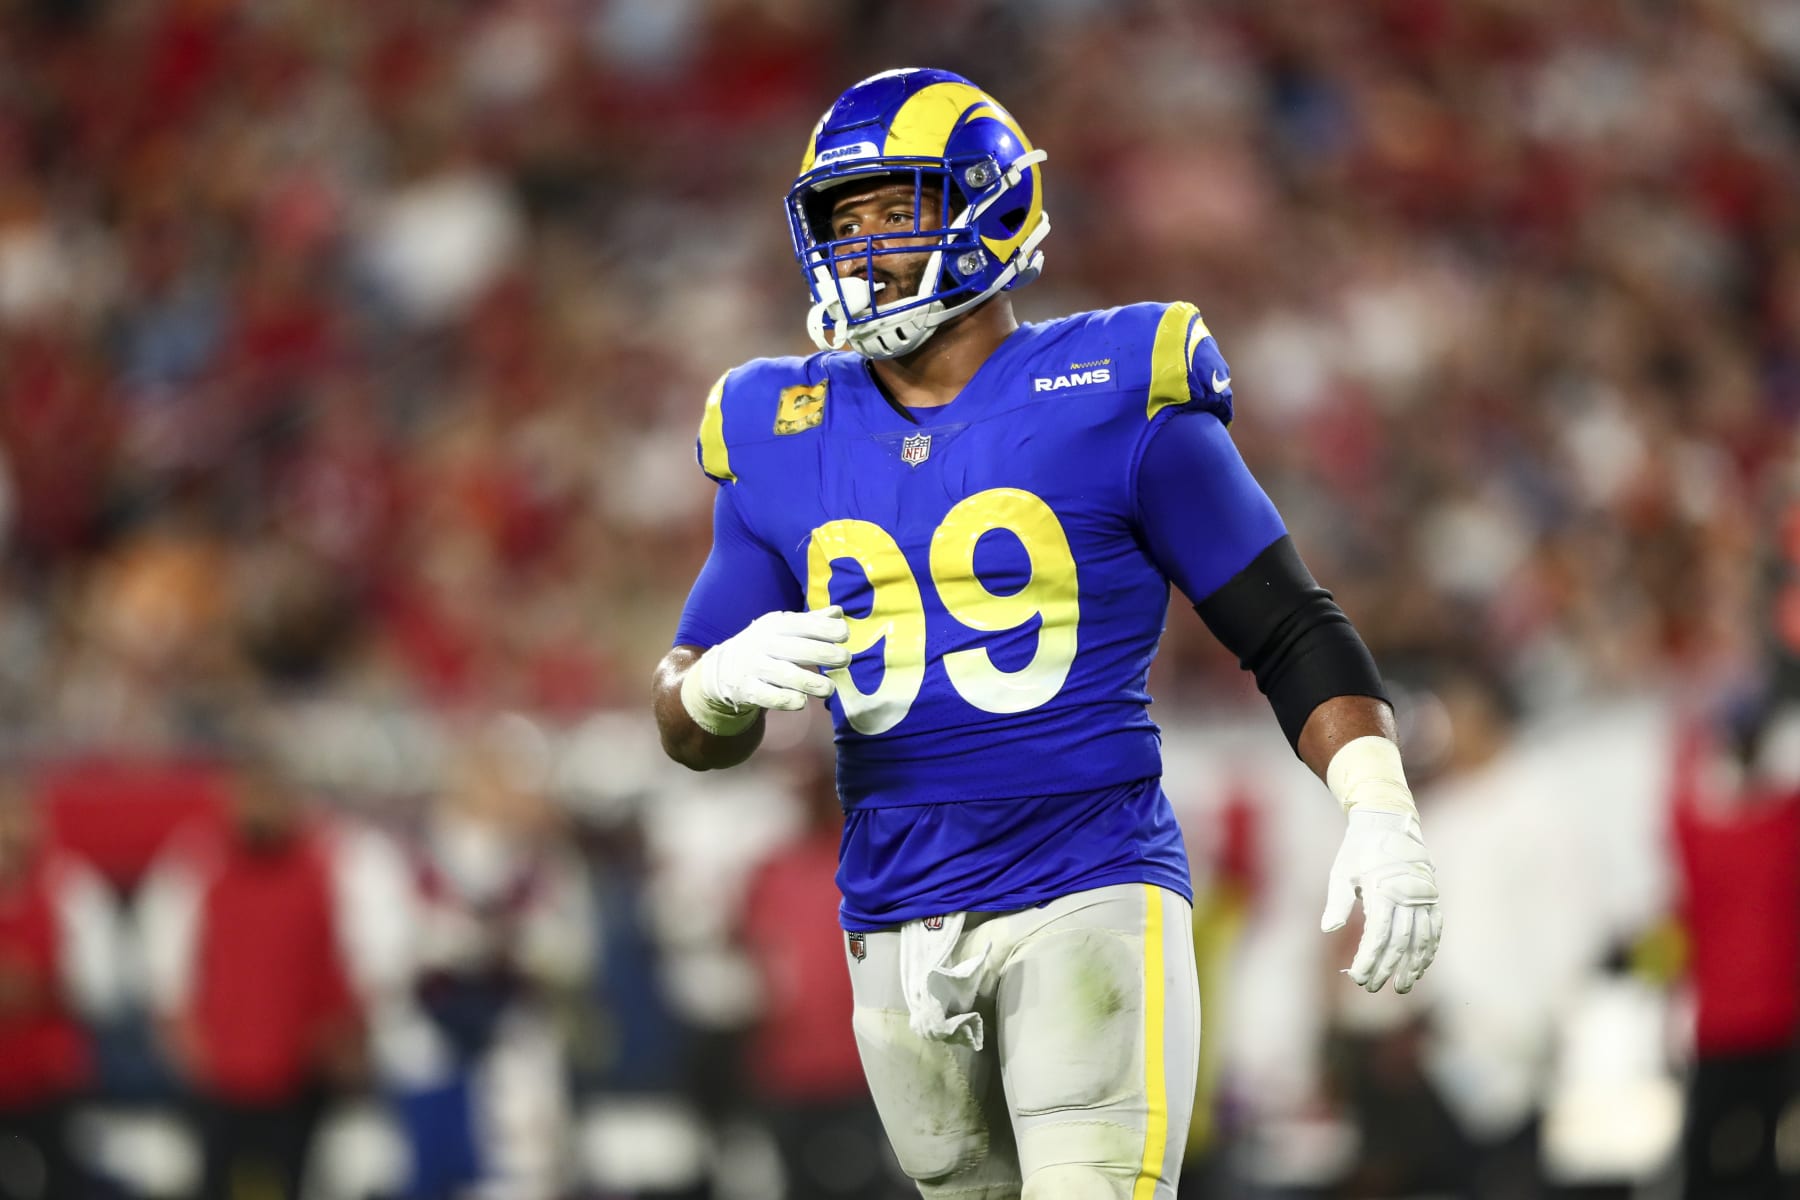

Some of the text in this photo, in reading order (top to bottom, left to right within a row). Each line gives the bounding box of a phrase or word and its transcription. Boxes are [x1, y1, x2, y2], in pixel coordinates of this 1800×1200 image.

[821, 145, 862, 162] RAMS
[1034, 368, 1110, 392] RAMS
[905, 447, 925, 460] NFL
[806, 487, 1079, 736] 99
